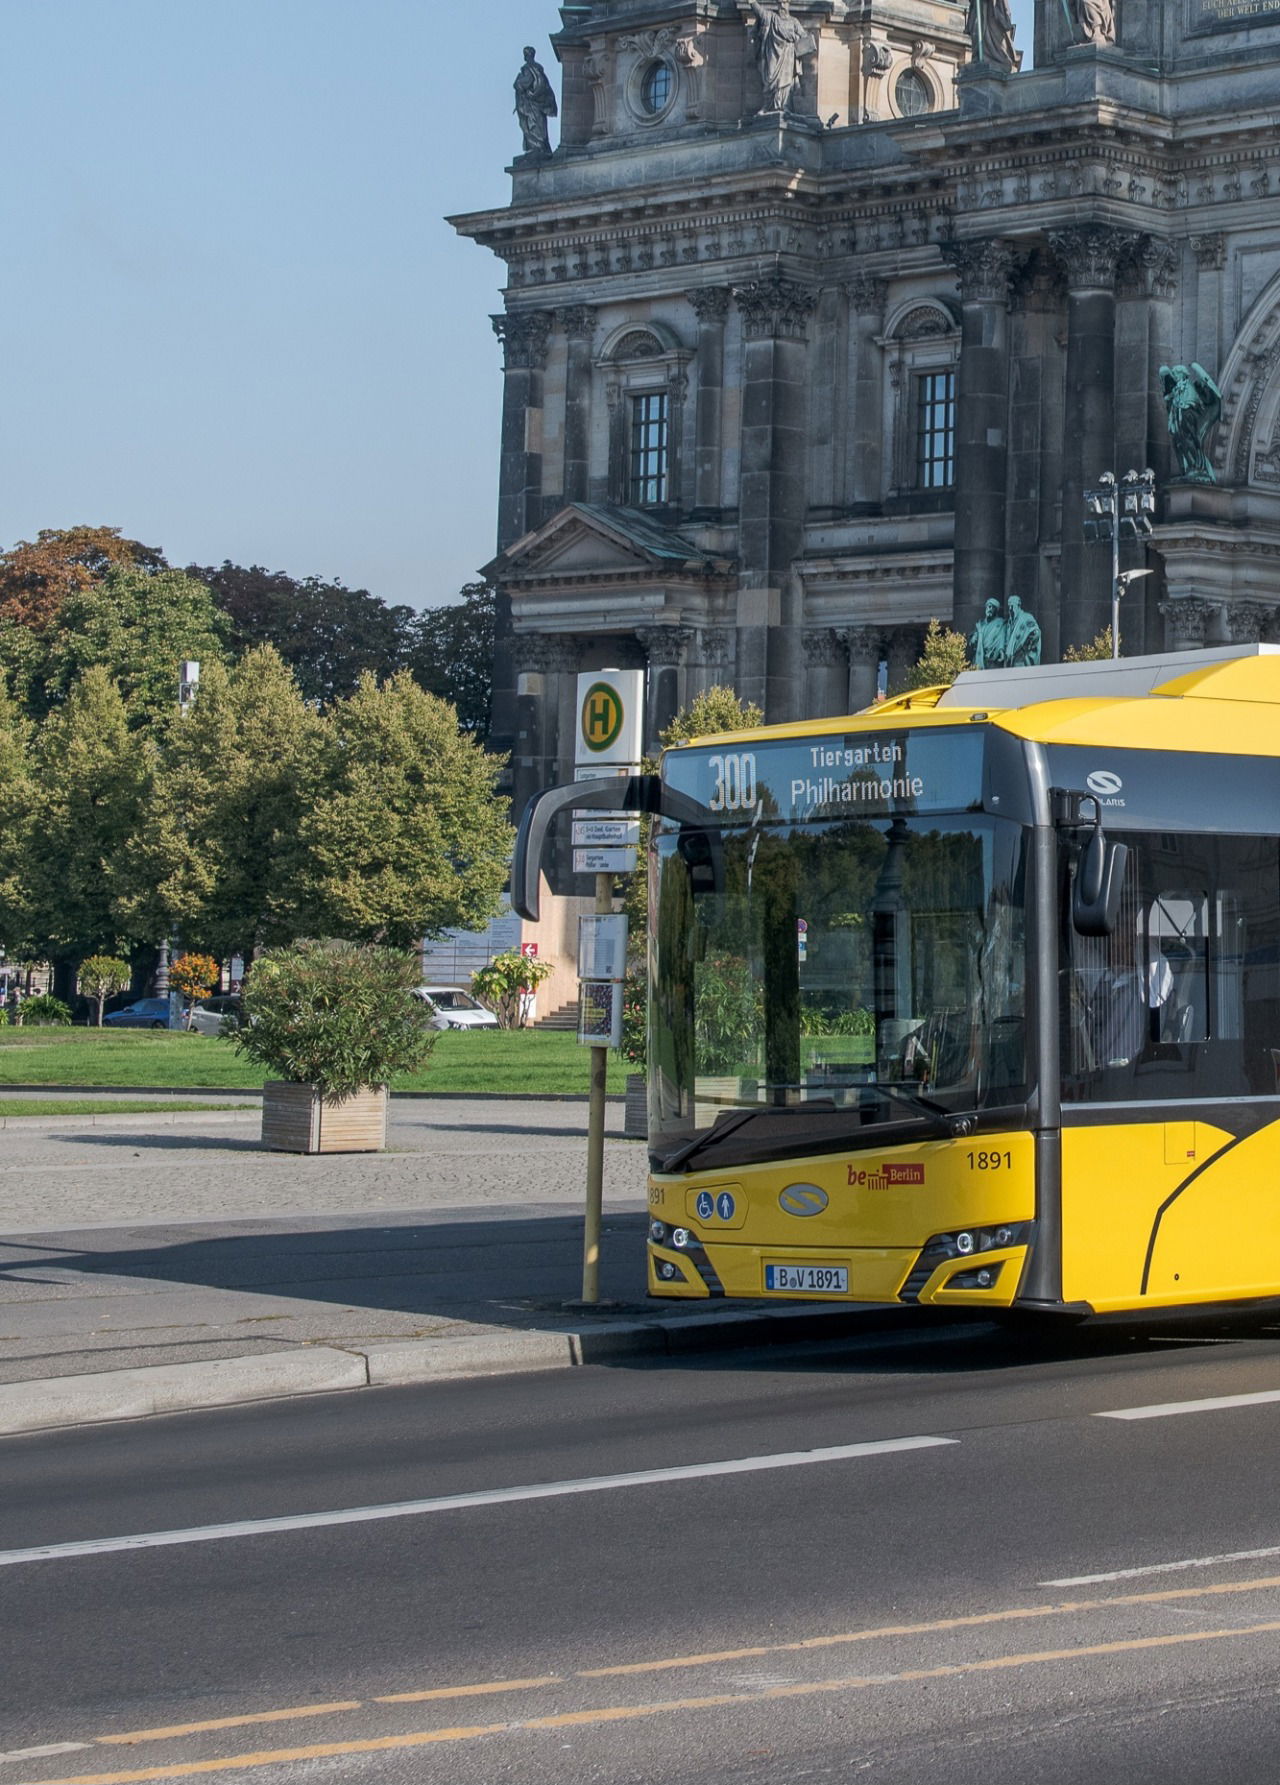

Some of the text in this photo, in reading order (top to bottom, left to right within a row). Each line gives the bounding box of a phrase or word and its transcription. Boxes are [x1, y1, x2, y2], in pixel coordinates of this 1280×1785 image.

[1236, 3, 1260, 15] WELT
[589, 699, 610, 735] H
[810, 743, 902, 768] Tiergarten
[708, 753, 757, 811] 300
[791, 772, 924, 805] Philharmonie
[1090, 799, 1126, 807] SLARIS
[966, 1151, 1012, 1170] 1891
[847, 1164, 921, 1186] be Berlin
[808, 1269, 842, 1289] 1891
